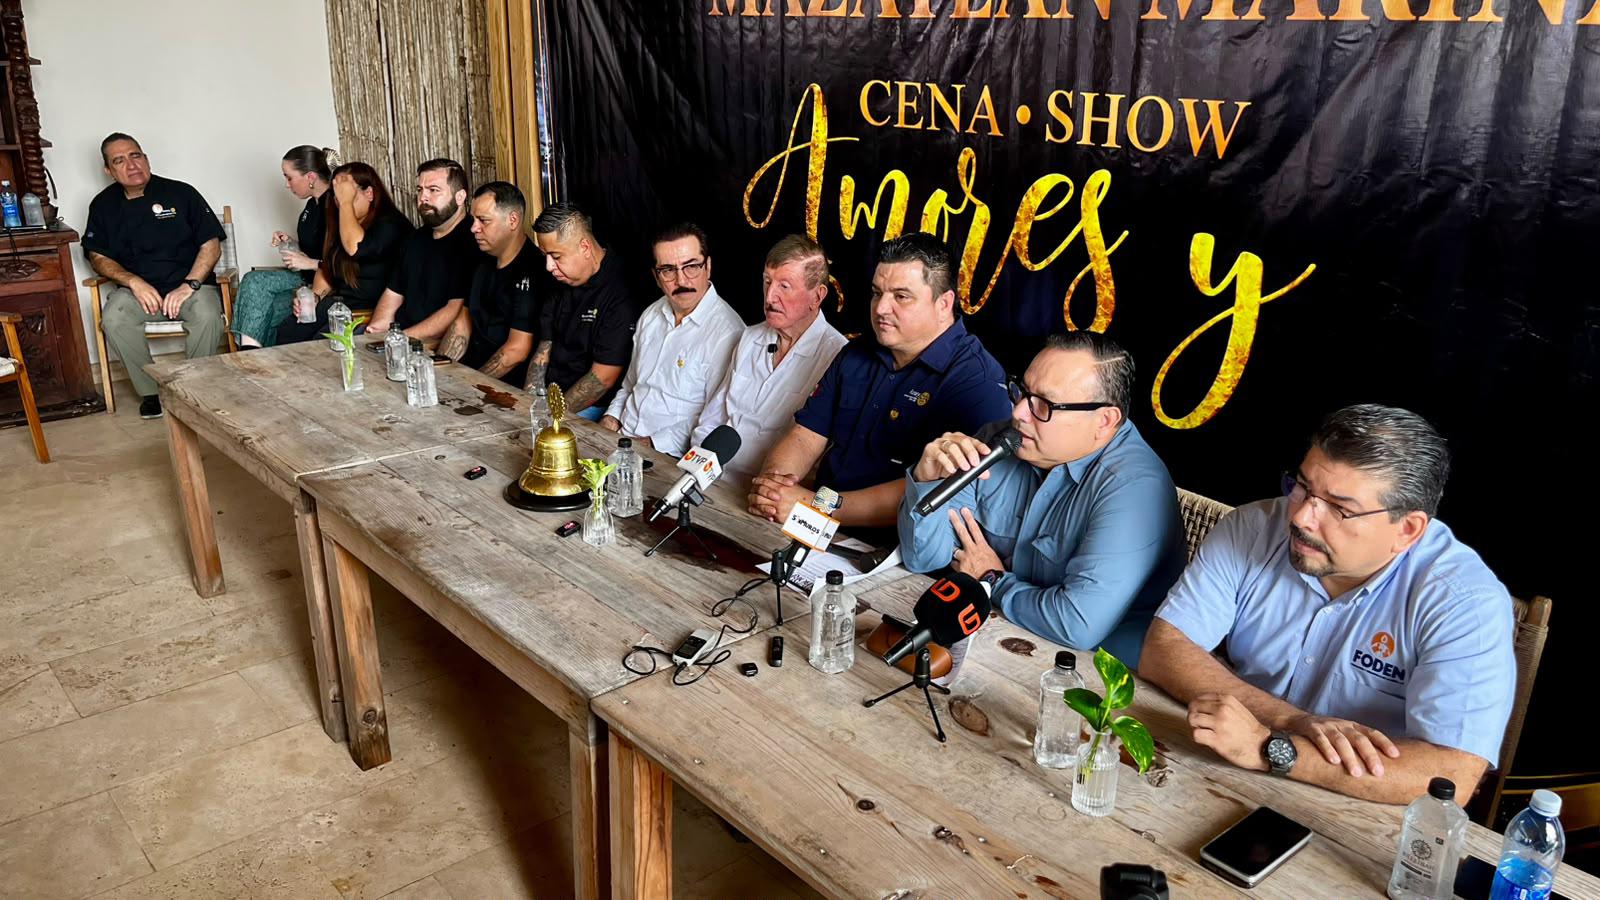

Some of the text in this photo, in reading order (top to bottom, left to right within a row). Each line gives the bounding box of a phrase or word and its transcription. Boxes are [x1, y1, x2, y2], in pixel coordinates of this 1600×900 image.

[859, 79, 1251, 159] CENA SHOW
[743, 83, 1316, 430] Amores y
[692, 454, 708, 465] TVP
[1352, 649, 1406, 681] FODEN
